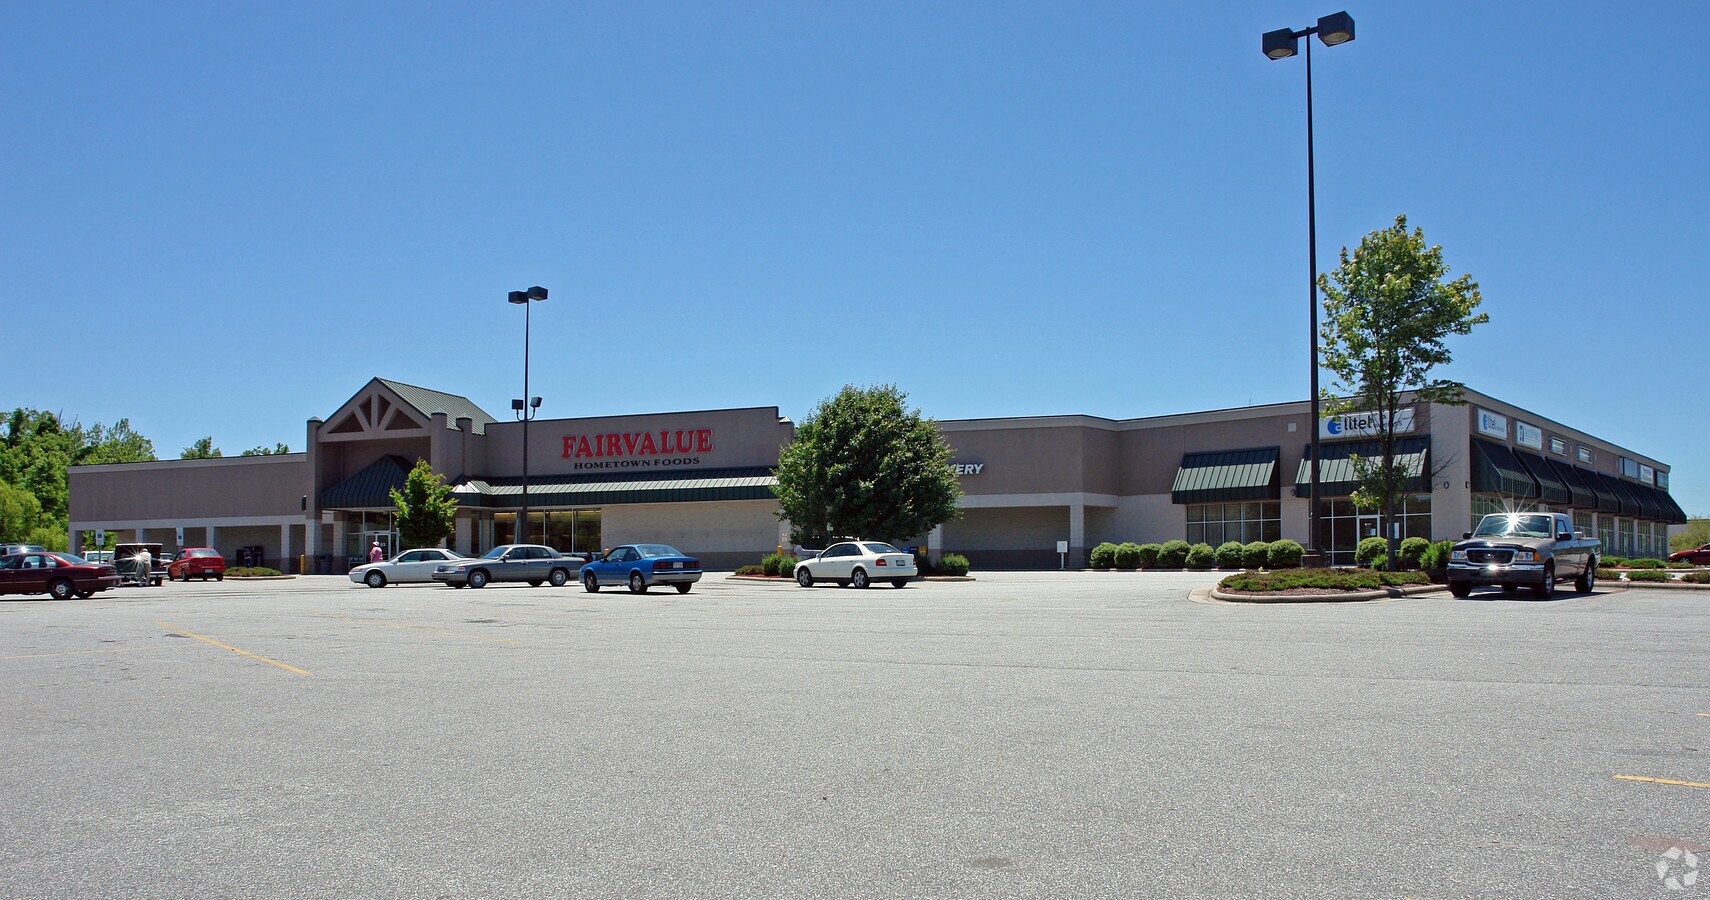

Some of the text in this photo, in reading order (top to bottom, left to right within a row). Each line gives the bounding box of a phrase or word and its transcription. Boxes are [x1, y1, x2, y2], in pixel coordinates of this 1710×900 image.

[562, 429, 713, 458] FAIRVALUE
[574, 457, 700, 470] HOMETOWN FOODS
[949, 463, 984, 475] ERY
